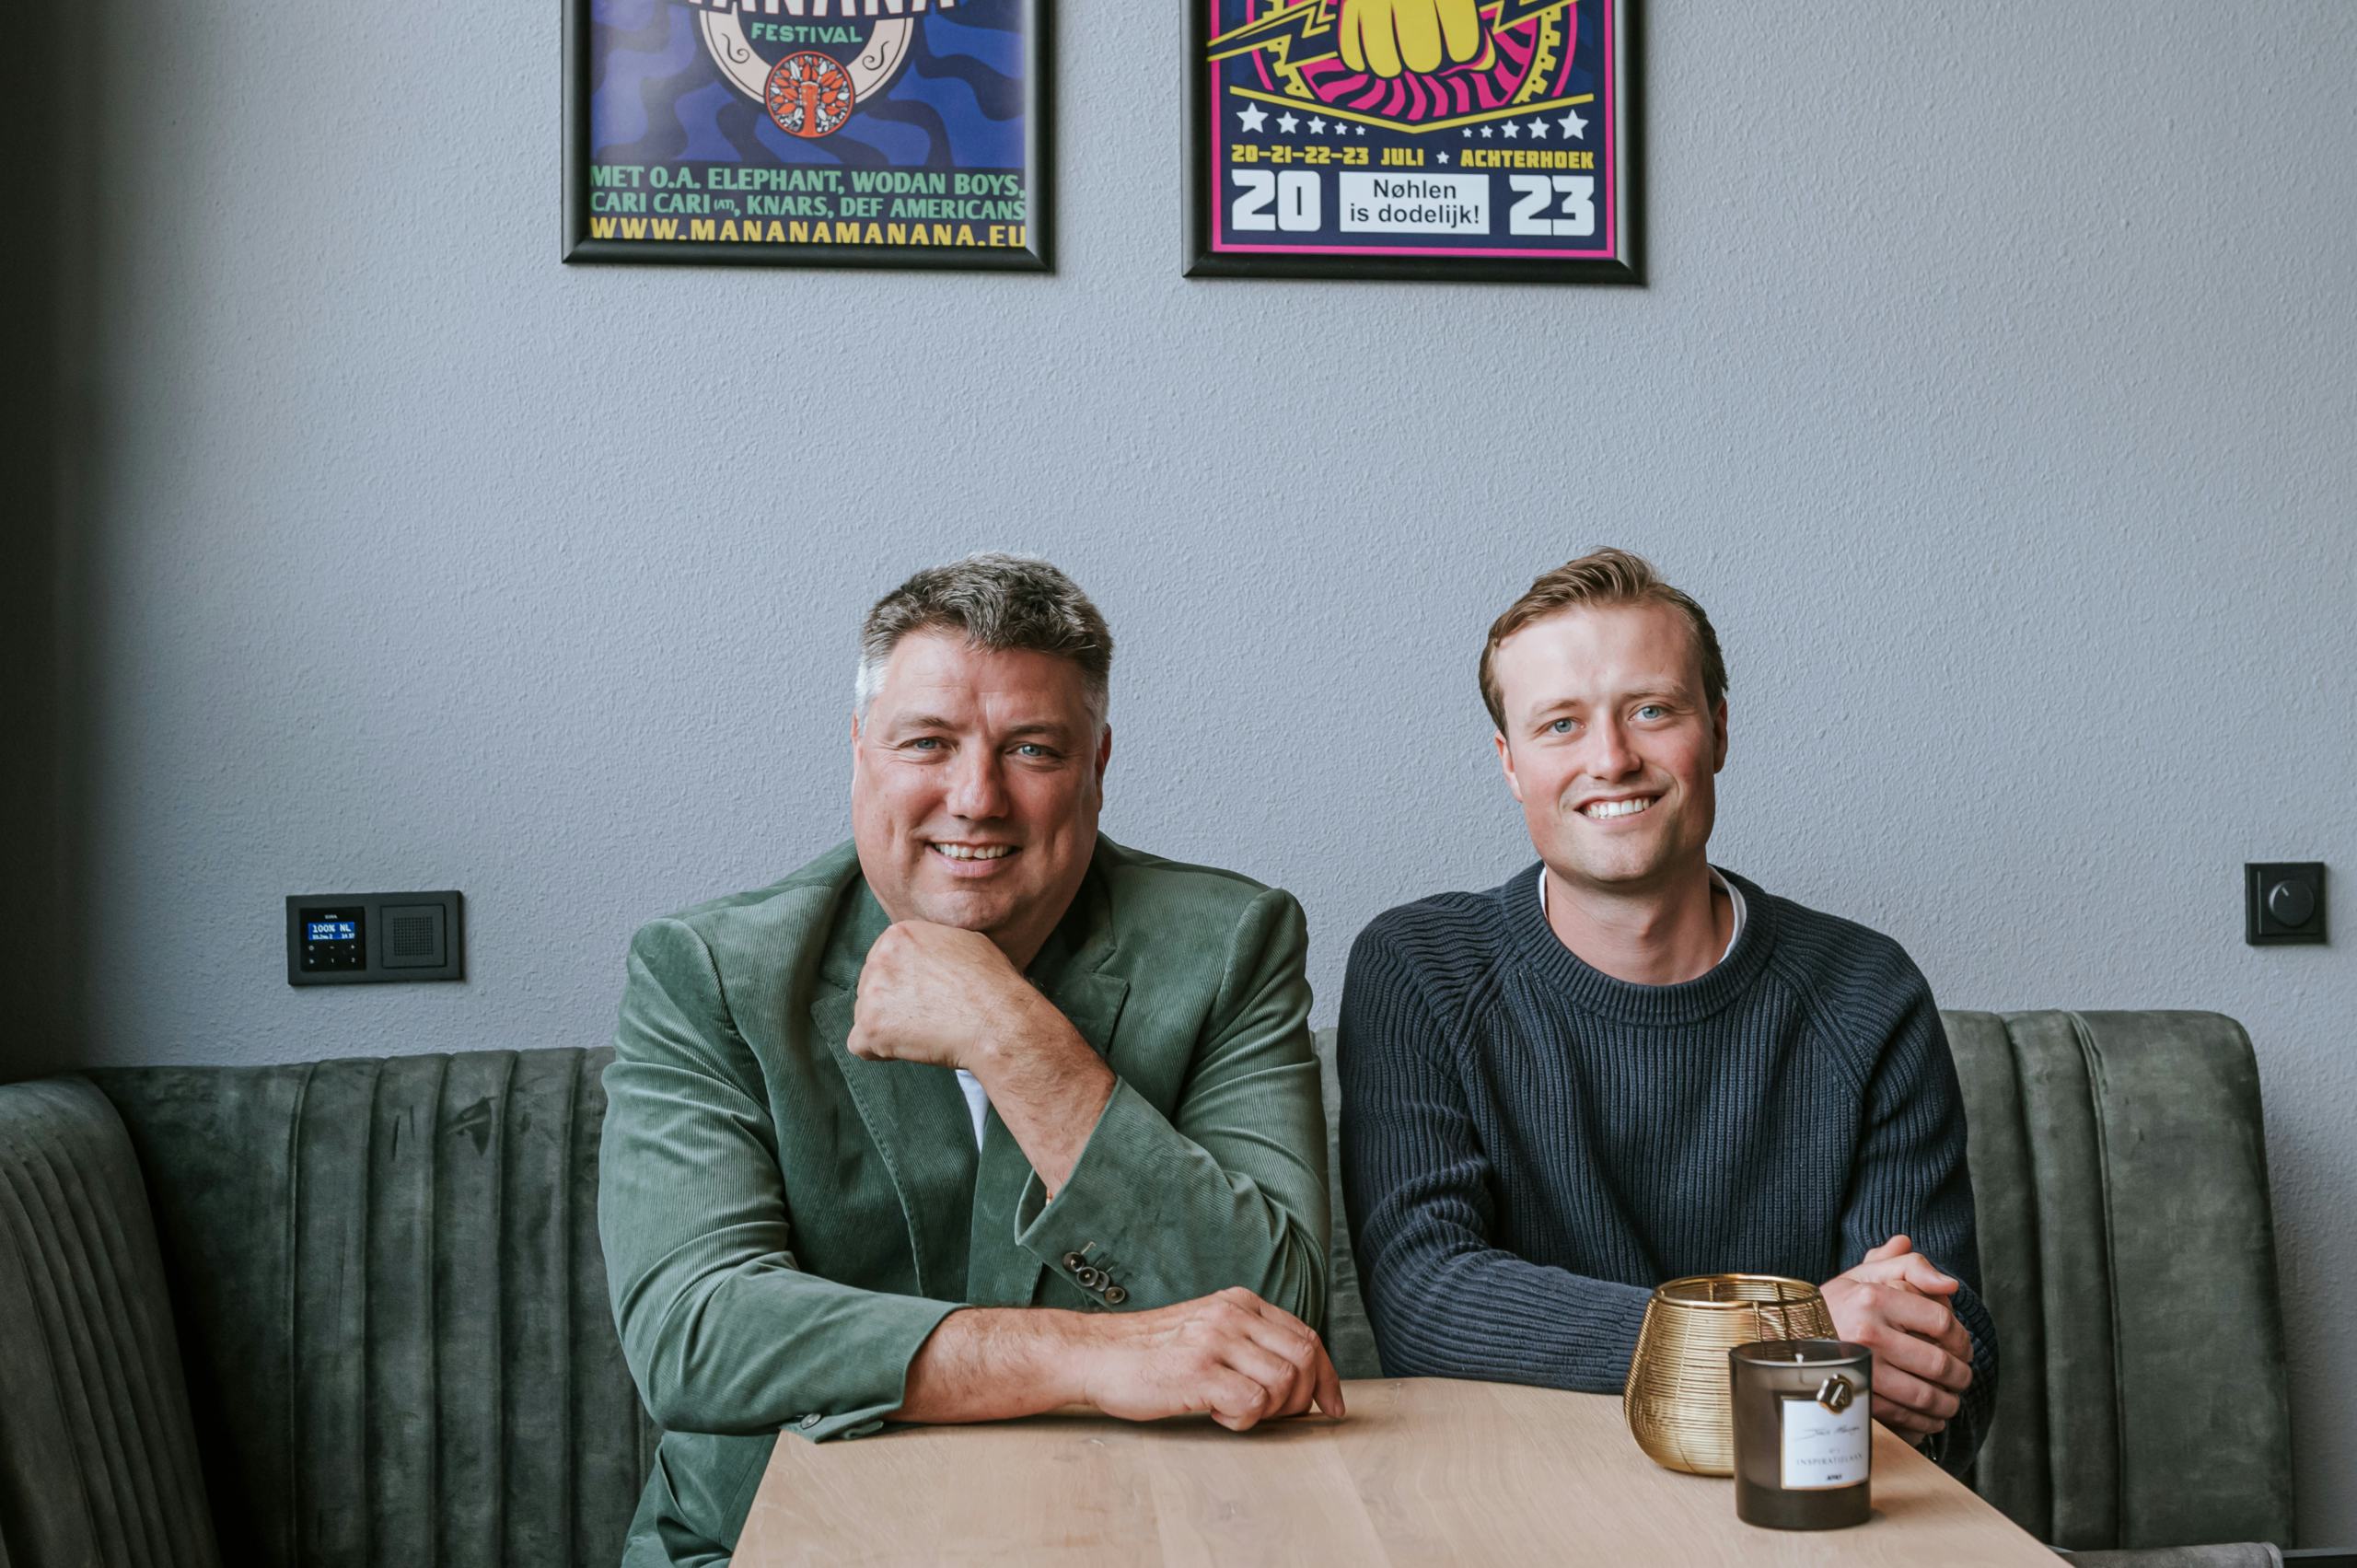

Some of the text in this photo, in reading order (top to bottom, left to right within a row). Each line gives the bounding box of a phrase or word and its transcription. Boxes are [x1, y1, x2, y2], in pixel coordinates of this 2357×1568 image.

[751, 22, 863, 43] FESTIVAL
[1232, 145, 1594, 169] 20-21-22-23 JULI ACHTERHOEK
[590, 165, 1026, 199] MET O.A. ELEPHANT, WODAN BOYS,
[1374, 179, 1457, 200] Nøhlen
[590, 192, 646, 213] CARI
[653, 192, 710, 214] CARI
[747, 195, 834, 219] KNARS,
[840, 197, 884, 217] DEF
[889, 198, 1026, 221] AMERICANS
[1232, 169, 1321, 232] 20
[1509, 174, 1595, 236] 23
[1350, 203, 1479, 228] is dodelijk!
[590, 217, 1026, 247] WWW.MANANAMANANA.EU
[312, 923, 352, 933] 100% NL
